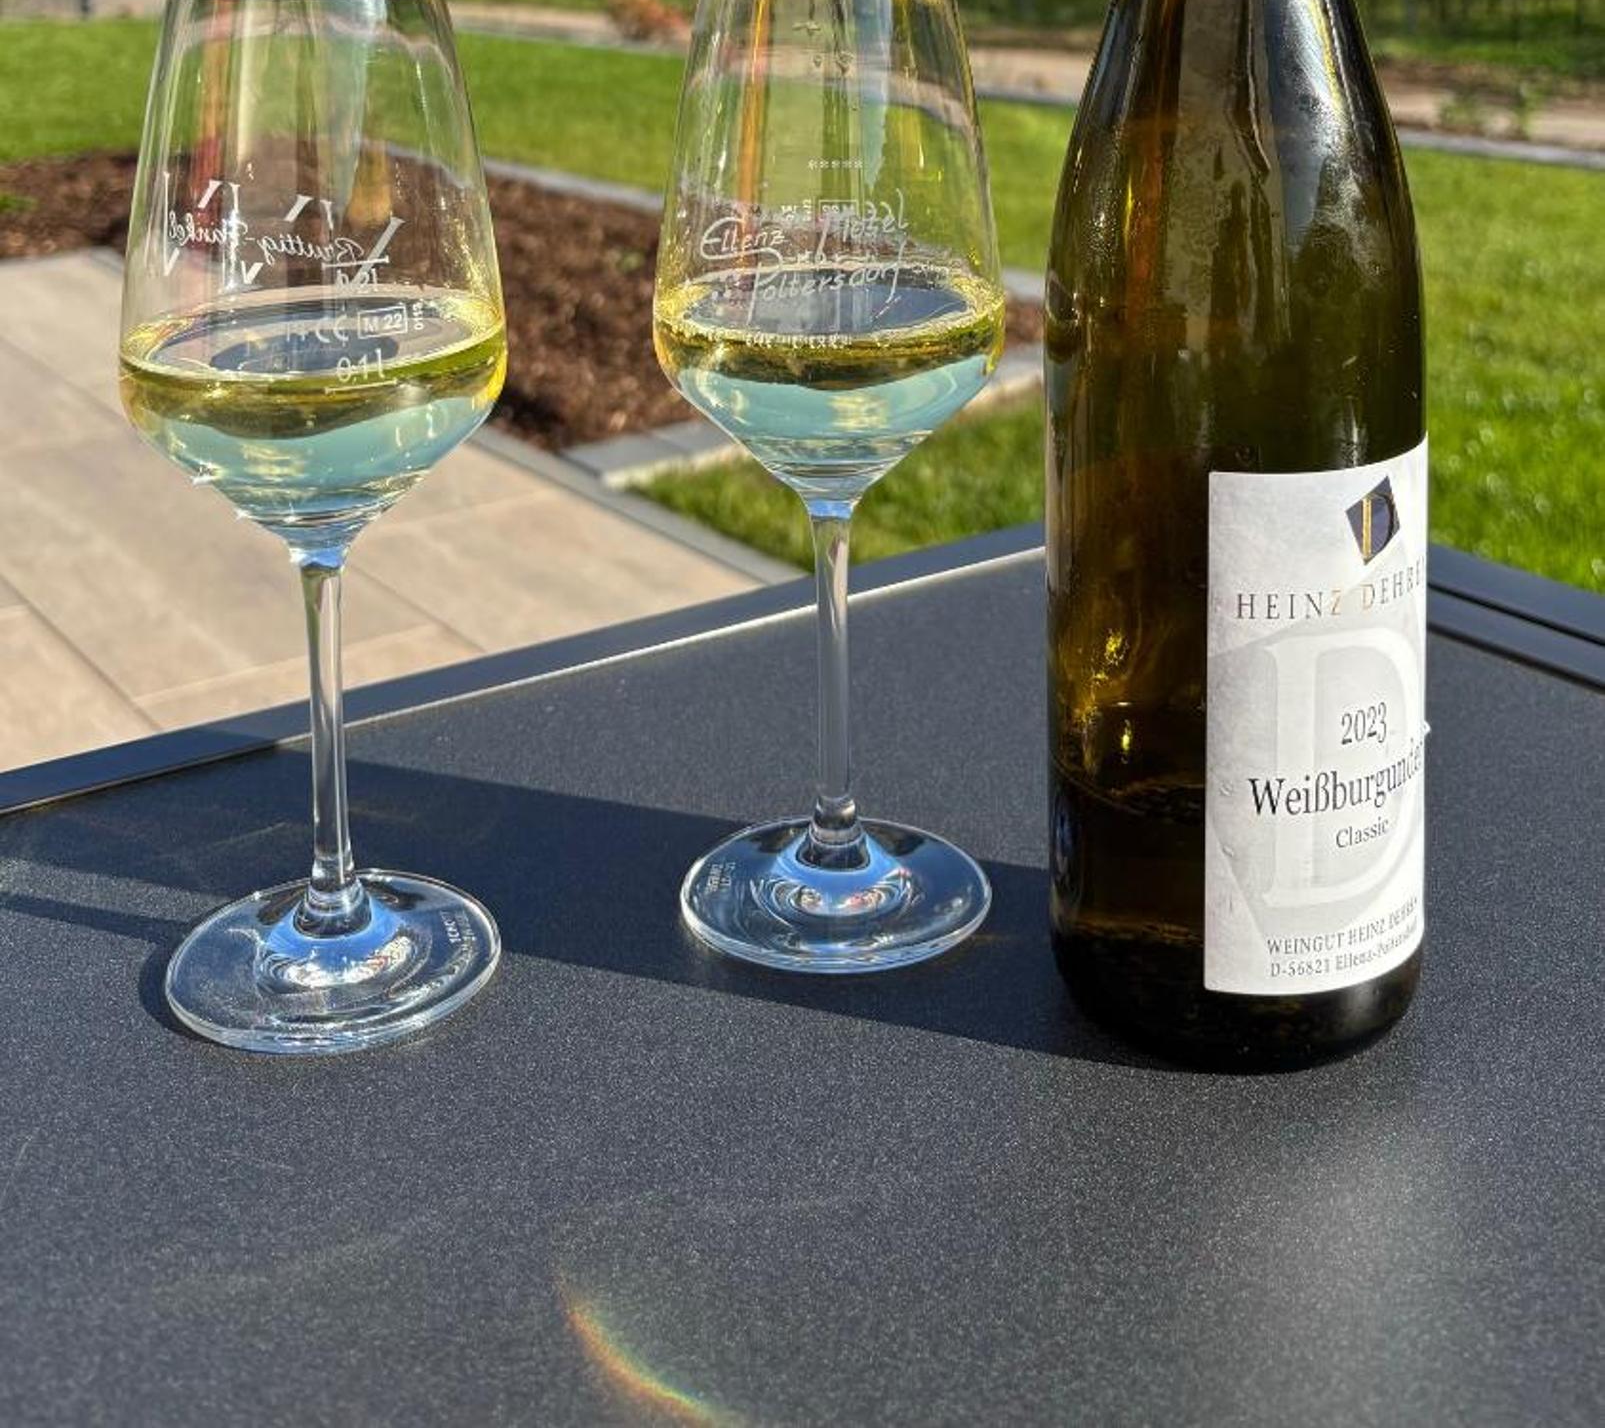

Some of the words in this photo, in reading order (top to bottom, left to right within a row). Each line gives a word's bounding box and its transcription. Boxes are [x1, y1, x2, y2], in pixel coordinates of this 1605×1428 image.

[1236, 590, 1342, 619] HEINZ
[1340, 702, 1388, 745] 2023
[1335, 816, 1389, 849] Classic
[1267, 932, 1345, 955] WEINGUT
[1348, 917, 1386, 945] HEINZ
[1270, 958, 1331, 977] D-56821
